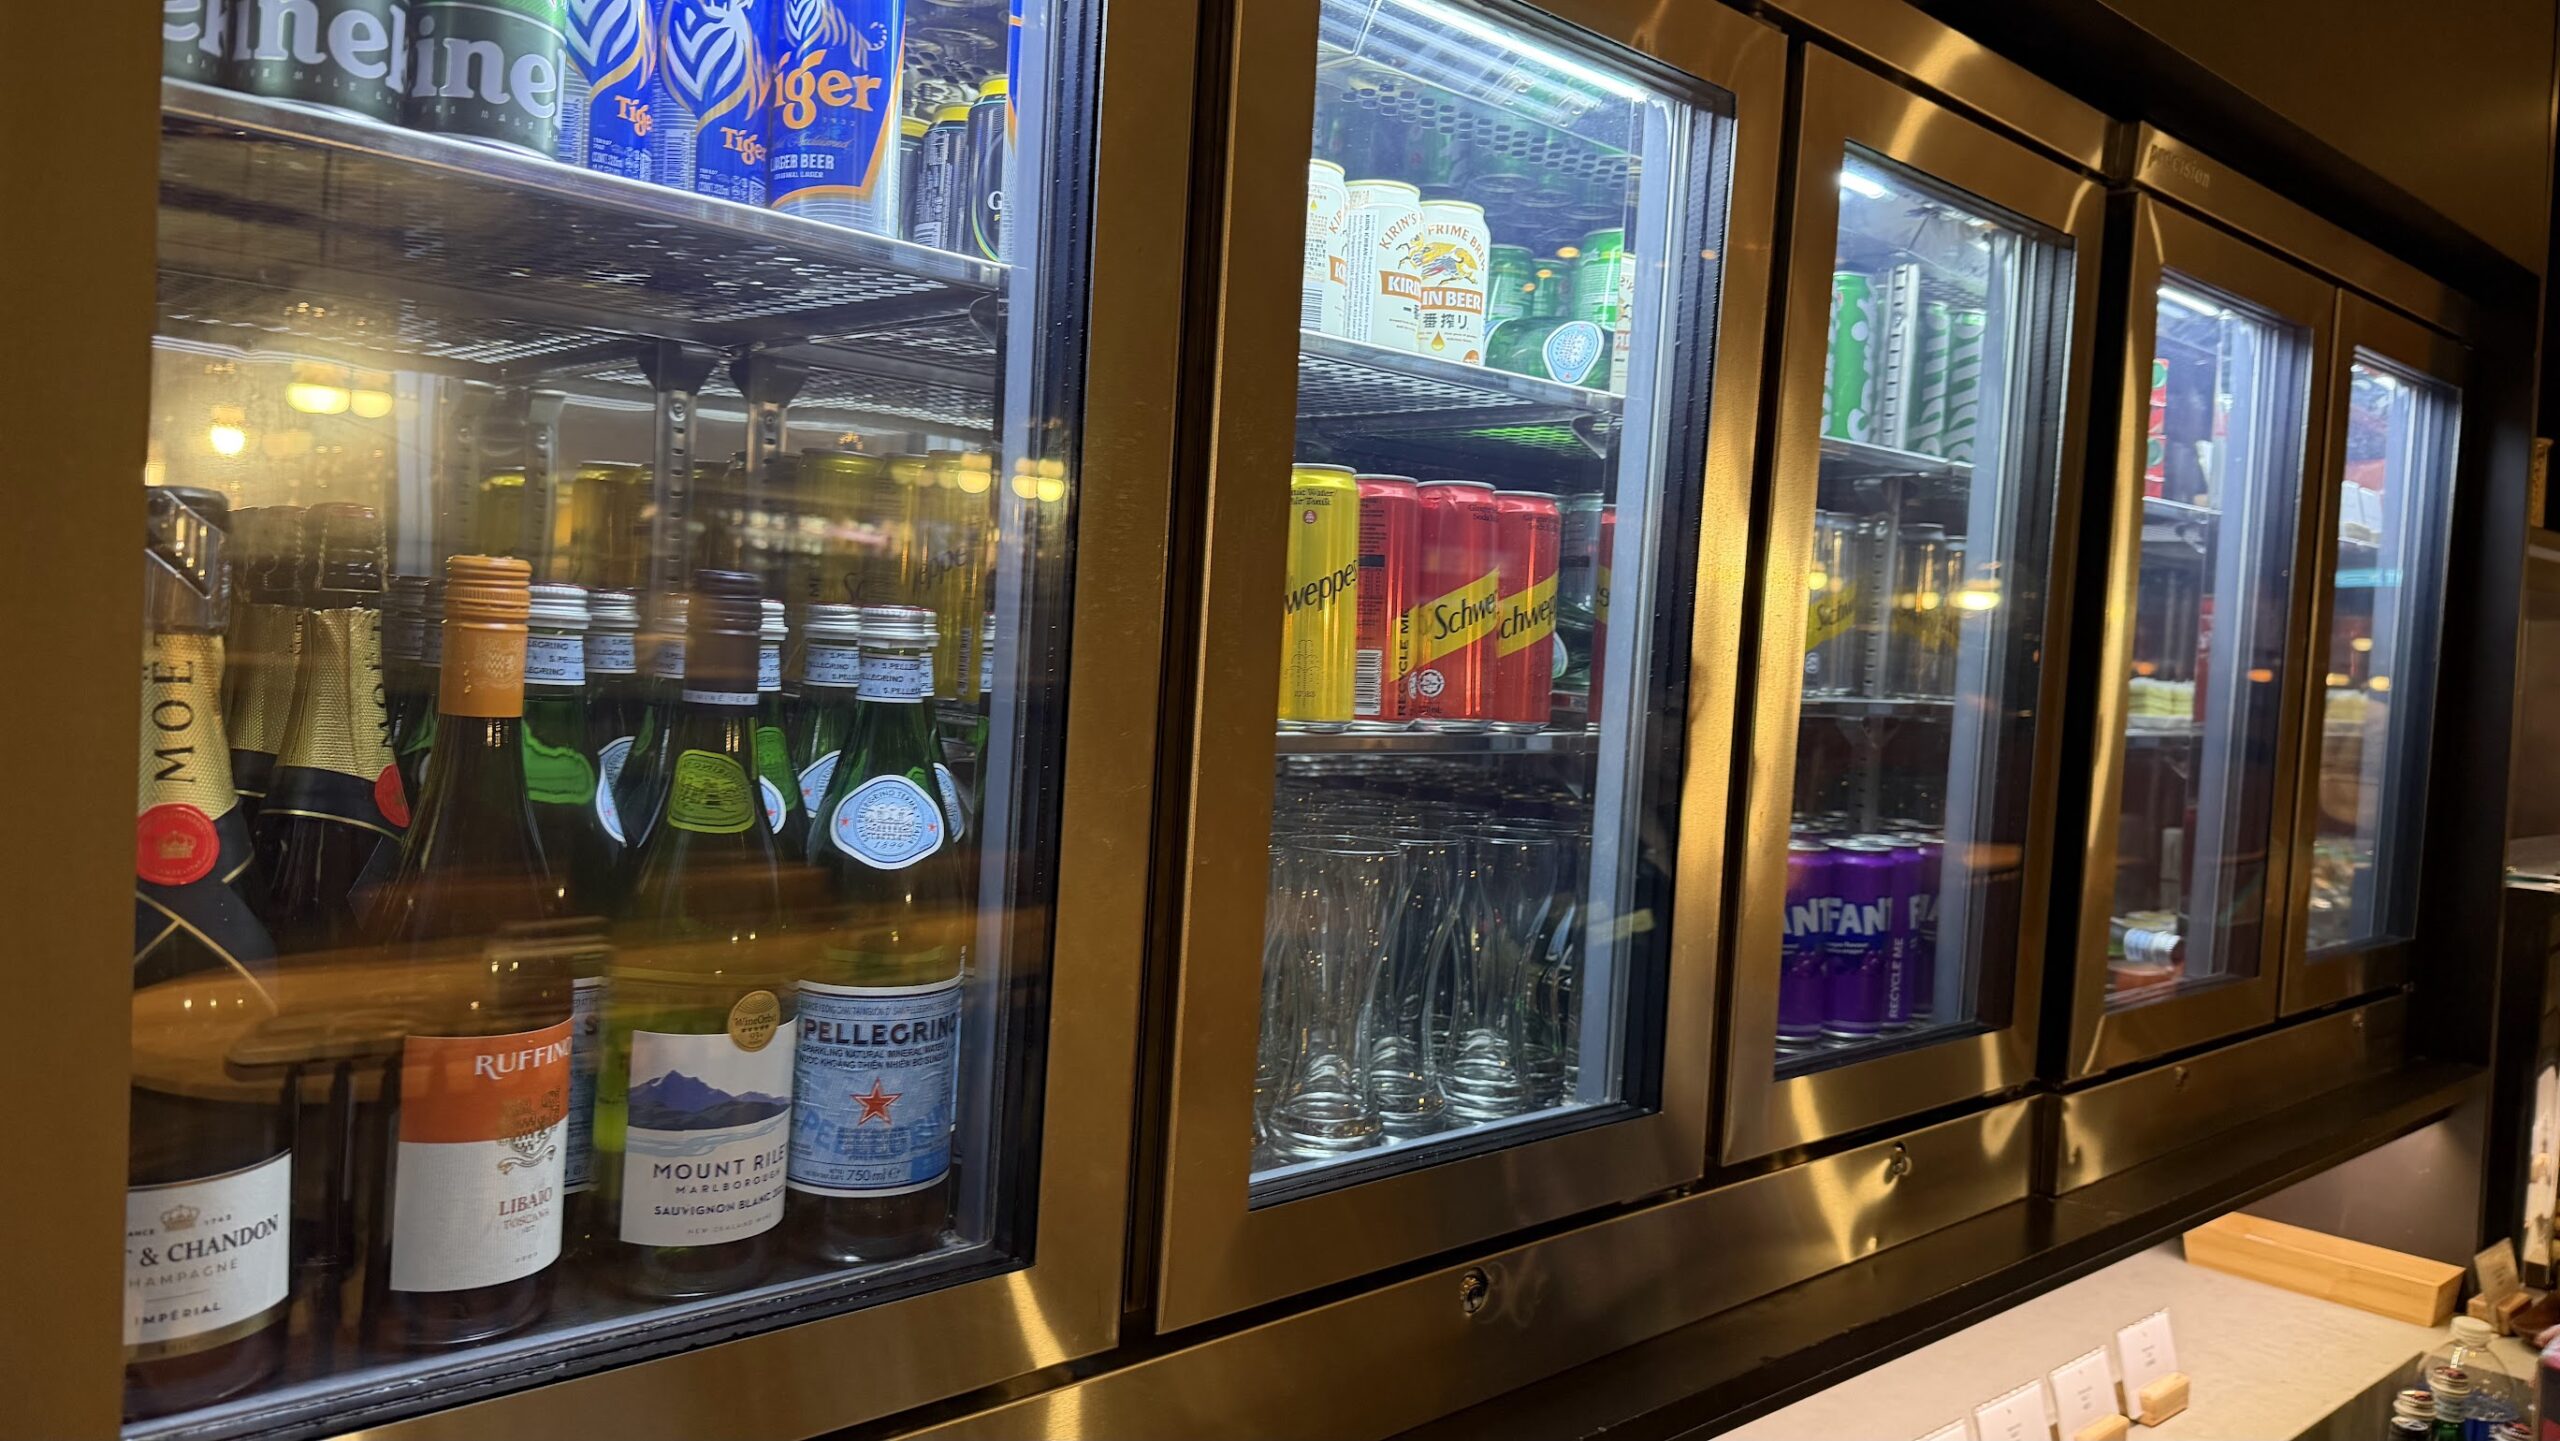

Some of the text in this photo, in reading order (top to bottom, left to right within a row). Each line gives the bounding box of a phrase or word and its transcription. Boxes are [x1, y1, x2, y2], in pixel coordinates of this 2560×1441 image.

[770, 48, 882, 130] iger
[614, 94, 653, 137] Tige
[800, 153, 835, 170] BEER
[1446, 291, 1481, 311] BEER
[1423, 311, 1467, 330] 番搾り
[143, 636, 196, 783] MOË
[653, 1143, 788, 1180] MOUNT RILE
[654, 1191, 772, 1216] SAUVIGNON BLANC
[139, 1213, 279, 1268] & CHANDON
[128, 1257, 239, 1290] HAMPAGNE
